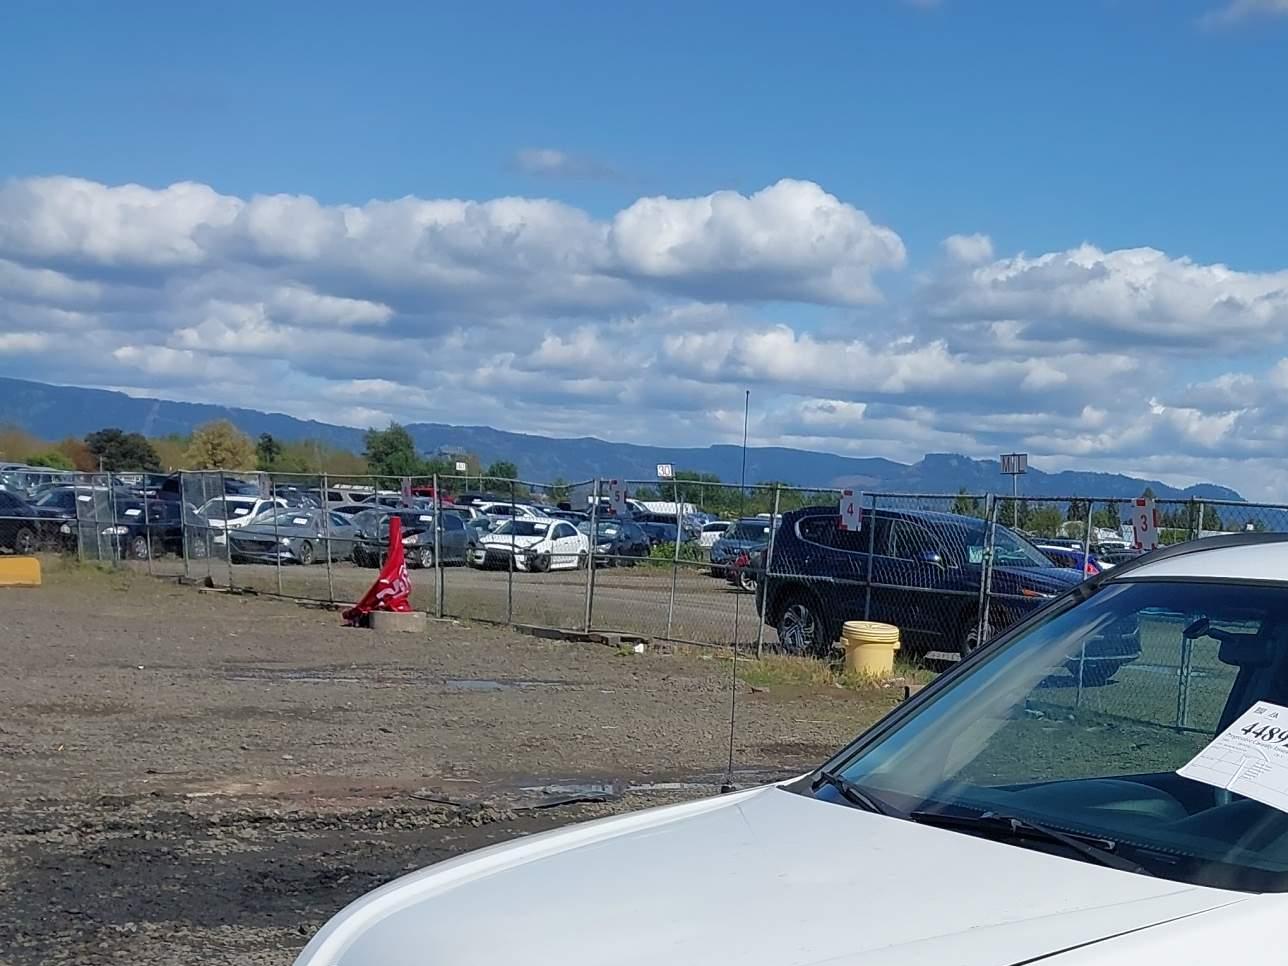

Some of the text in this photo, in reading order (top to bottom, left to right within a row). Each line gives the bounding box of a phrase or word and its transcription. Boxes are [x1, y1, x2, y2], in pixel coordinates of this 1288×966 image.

[658, 465, 670, 476] 30
[847, 502, 854, 517] 4
[1140, 514, 1148, 532] 3
